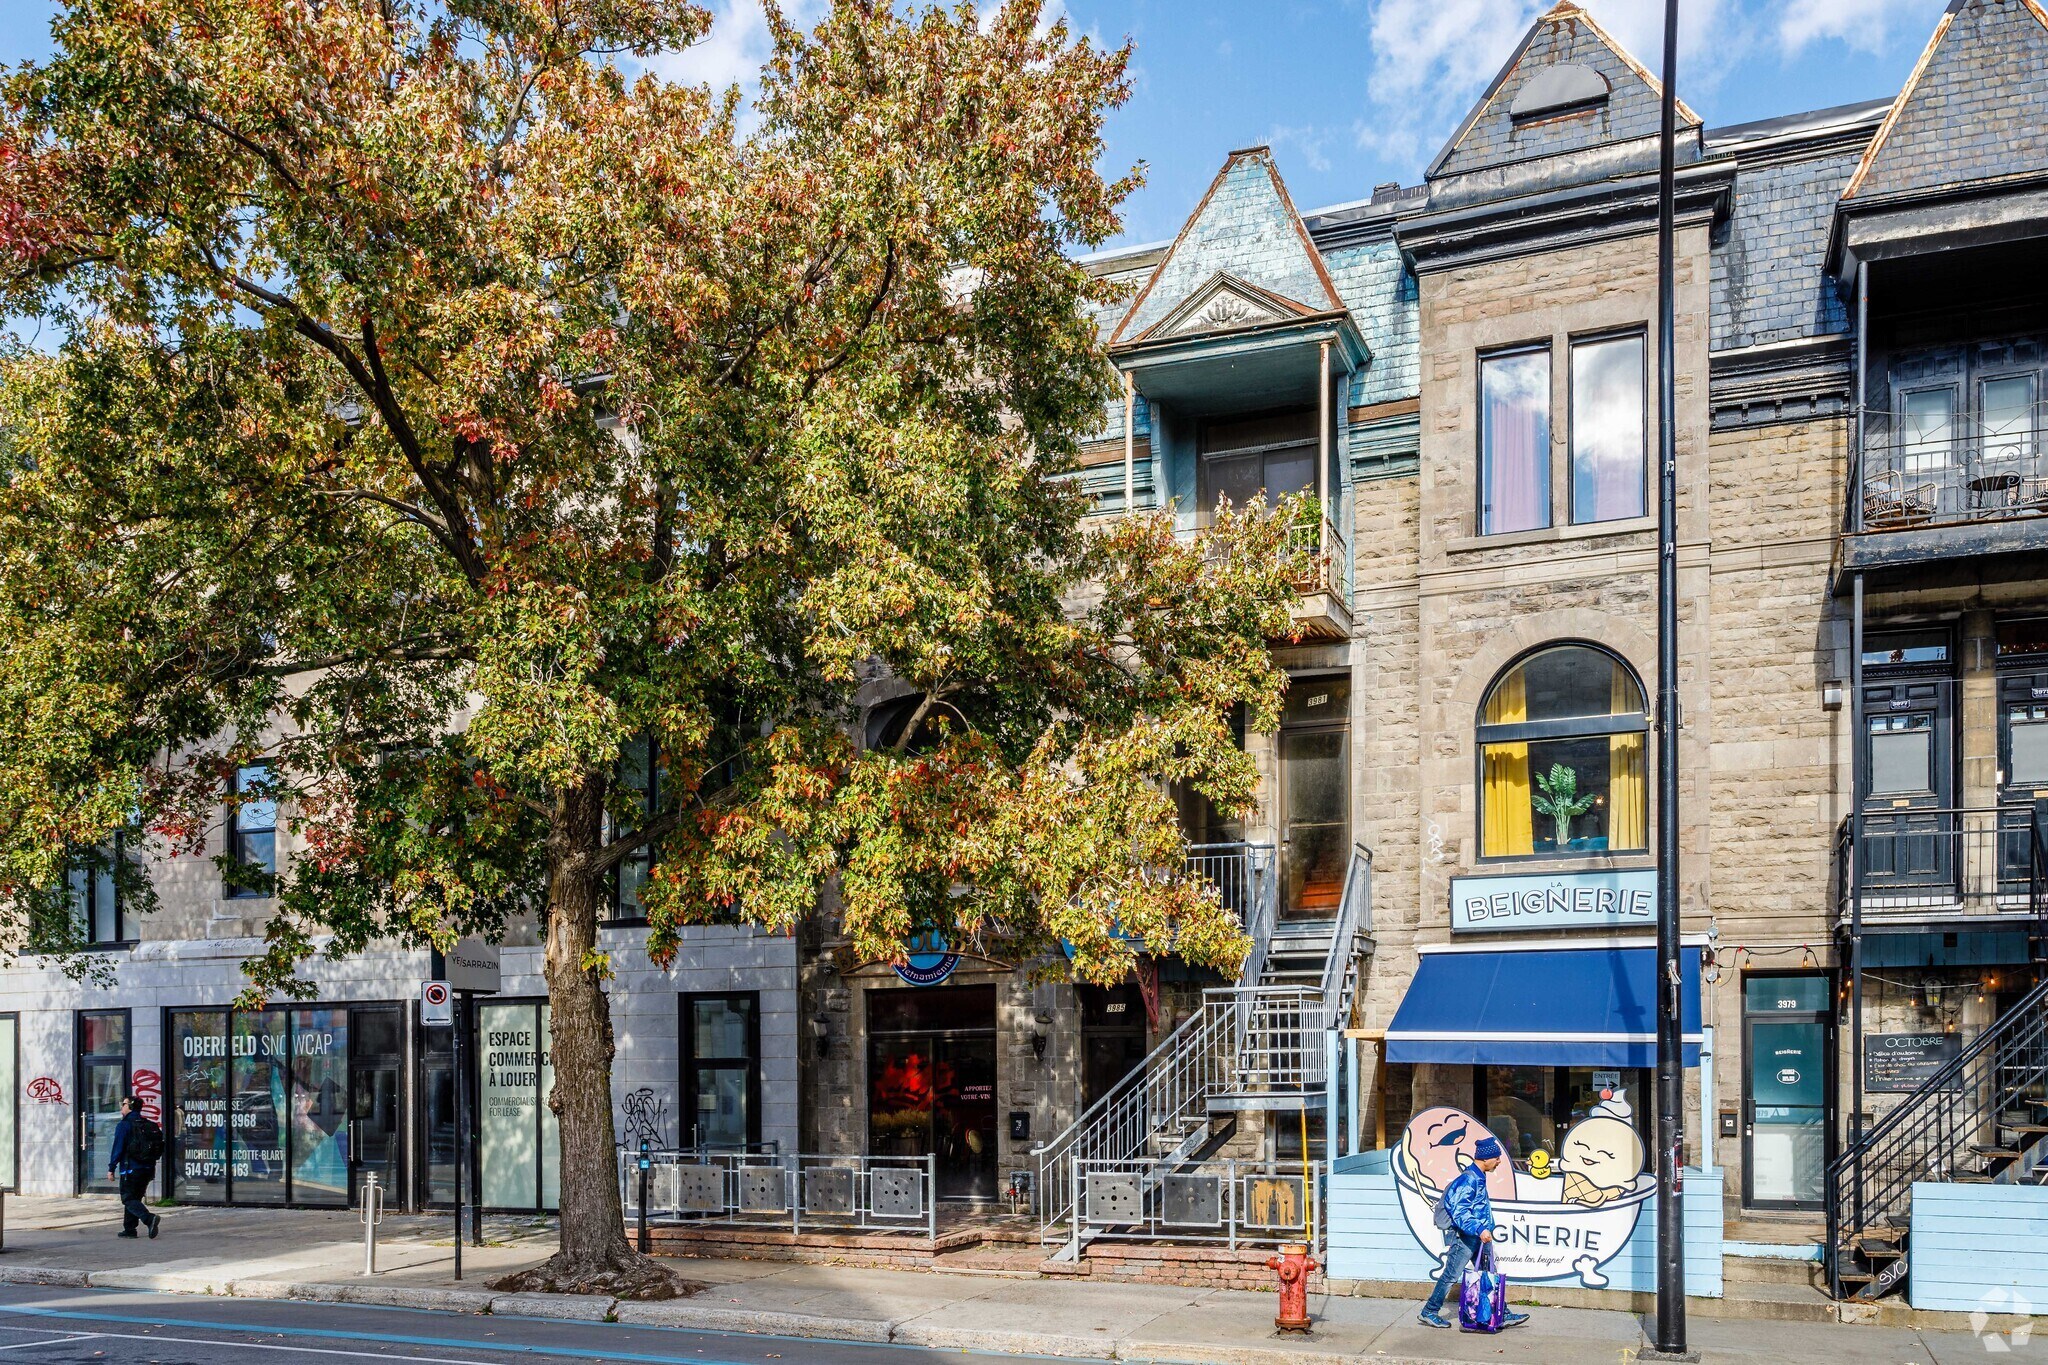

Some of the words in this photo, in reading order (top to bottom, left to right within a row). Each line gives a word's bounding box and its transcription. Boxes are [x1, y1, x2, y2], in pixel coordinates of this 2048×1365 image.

[1465, 887, 1652, 922] BEIGNERIE
[451, 956, 499, 970] YE/SARRAZIN
[901, 955, 955, 981] ietnamienne
[1777, 1000, 1797, 1009] 3979
[489, 1032, 531, 1046] ESPACE
[1885, 1037, 1944, 1048] OCTOBRE
[489, 1068, 496, 1086] À
[501, 1072, 536, 1086] LOUER
[184, 1100, 209, 1111] MANON
[489, 1097, 529, 1106] COMMERCIAL
[489, 1107, 501, 1116] FOR
[503, 1107, 521, 1116] LEASE
[184, 1114, 203, 1127] 438
[185, 1149, 217, 1160] MICHELLE
[185, 1162, 201, 1177] 514
[1513, 1214, 1526, 1222] LA
[1537, 1254, 1565, 1267] beigne!
